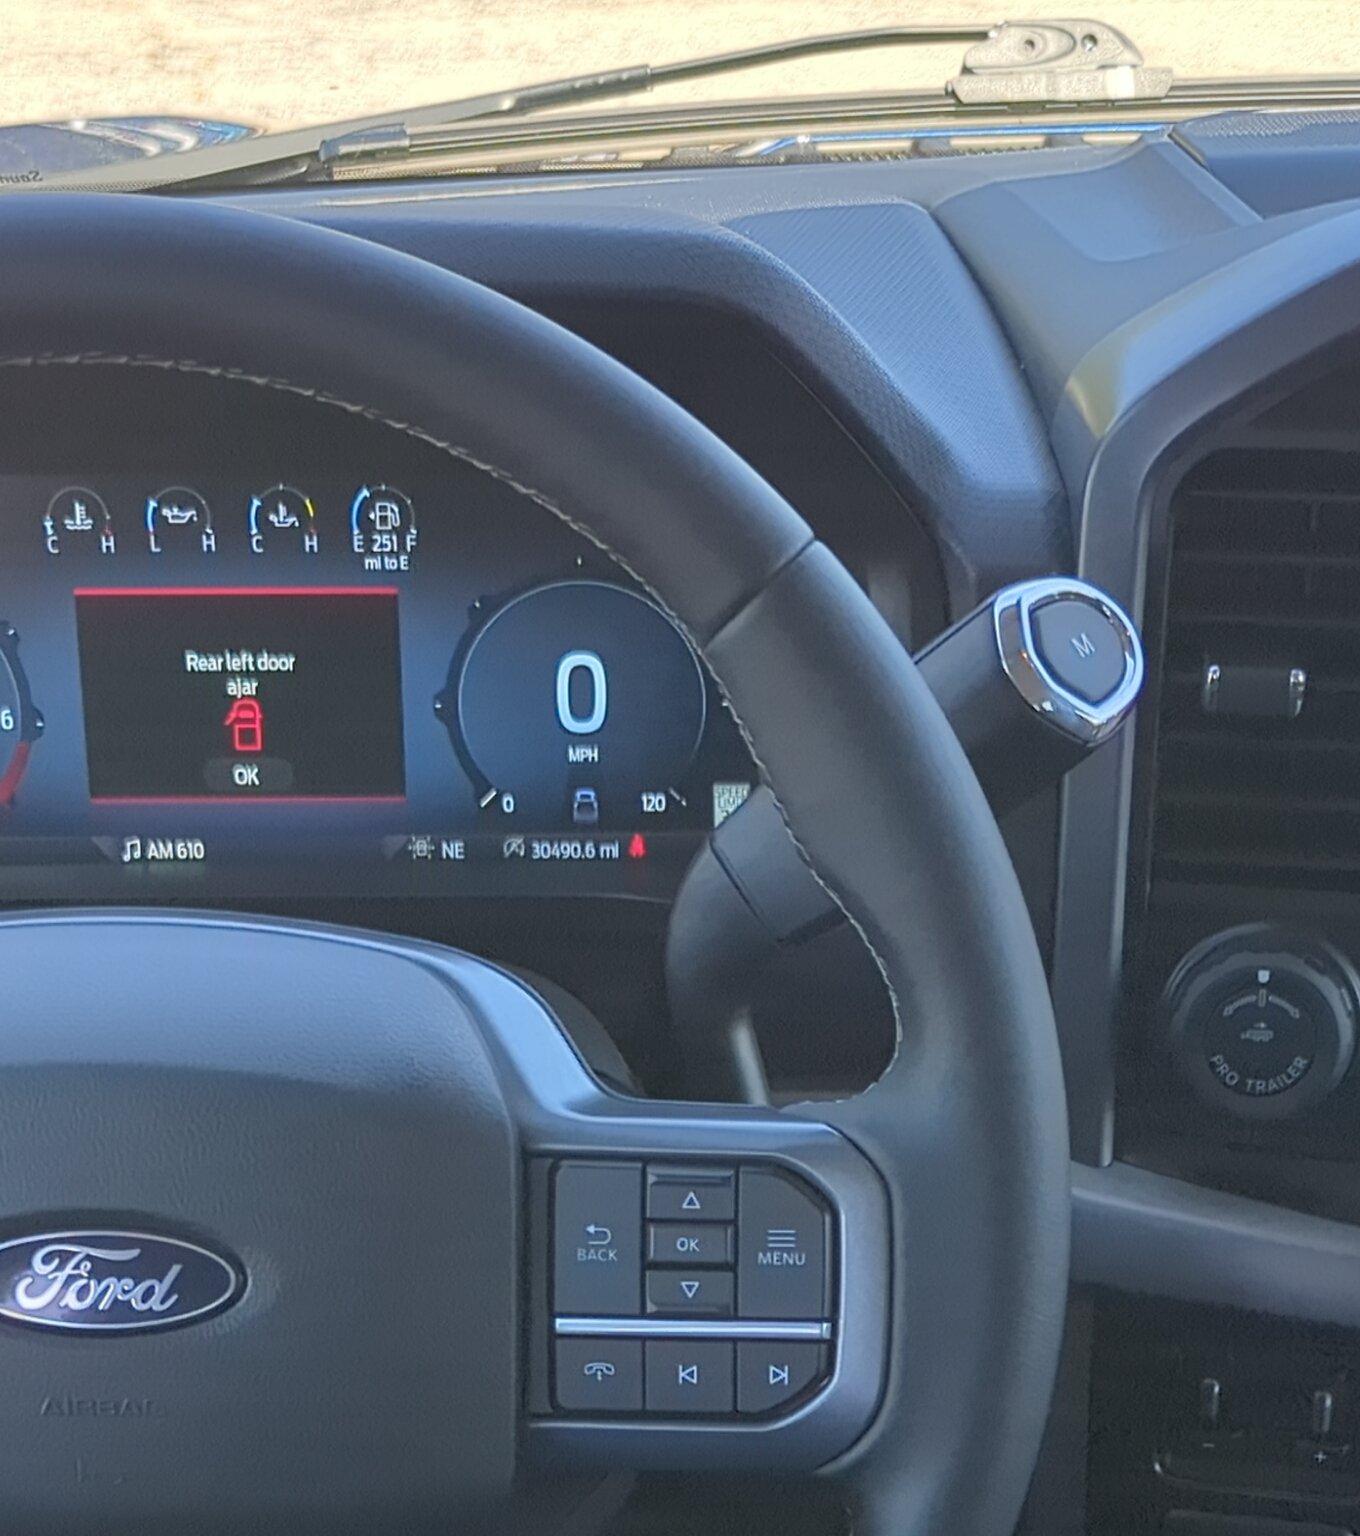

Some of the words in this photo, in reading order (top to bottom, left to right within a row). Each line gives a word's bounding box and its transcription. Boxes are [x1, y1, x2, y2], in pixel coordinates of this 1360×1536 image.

[47, 536, 60, 554] C
[101, 536, 115, 554] H
[149, 535, 161, 552] L
[202, 534, 216, 552] H
[251, 535, 264, 553] C
[304, 535, 318, 553] H
[353, 535, 364, 552] E
[372, 535, 399, 552] 251
[406, 534, 418, 552] F
[385, 556, 398, 571] to
[400, 556, 409, 570] E
[185, 651, 223, 672] Rear
[225, 650, 255, 672] left
[257, 651, 296, 672] door
[226, 678, 258, 699] ajar
[554, 649, 607, 735] 0
[0, 710, 14, 731] 6
[567, 745, 599, 763] MPH
[233, 765, 259, 786] OK
[502, 793, 514, 813] 0
[641, 793, 666, 813] 120
[146, 841, 174, 860] AM
[177, 841, 206, 860] 610
[441, 841, 465, 860] NE
[531, 841, 596, 860] 30490.6
[1210, 1055, 1238, 1086] PRO
[1245, 1055, 1309, 1093] TRAILER
[676, 1239, 700, 1252] OK
[577, 1249, 618, 1262] BACK
[758, 1252, 806, 1265] MENU
[15, 1244, 183, 1312] Ford
